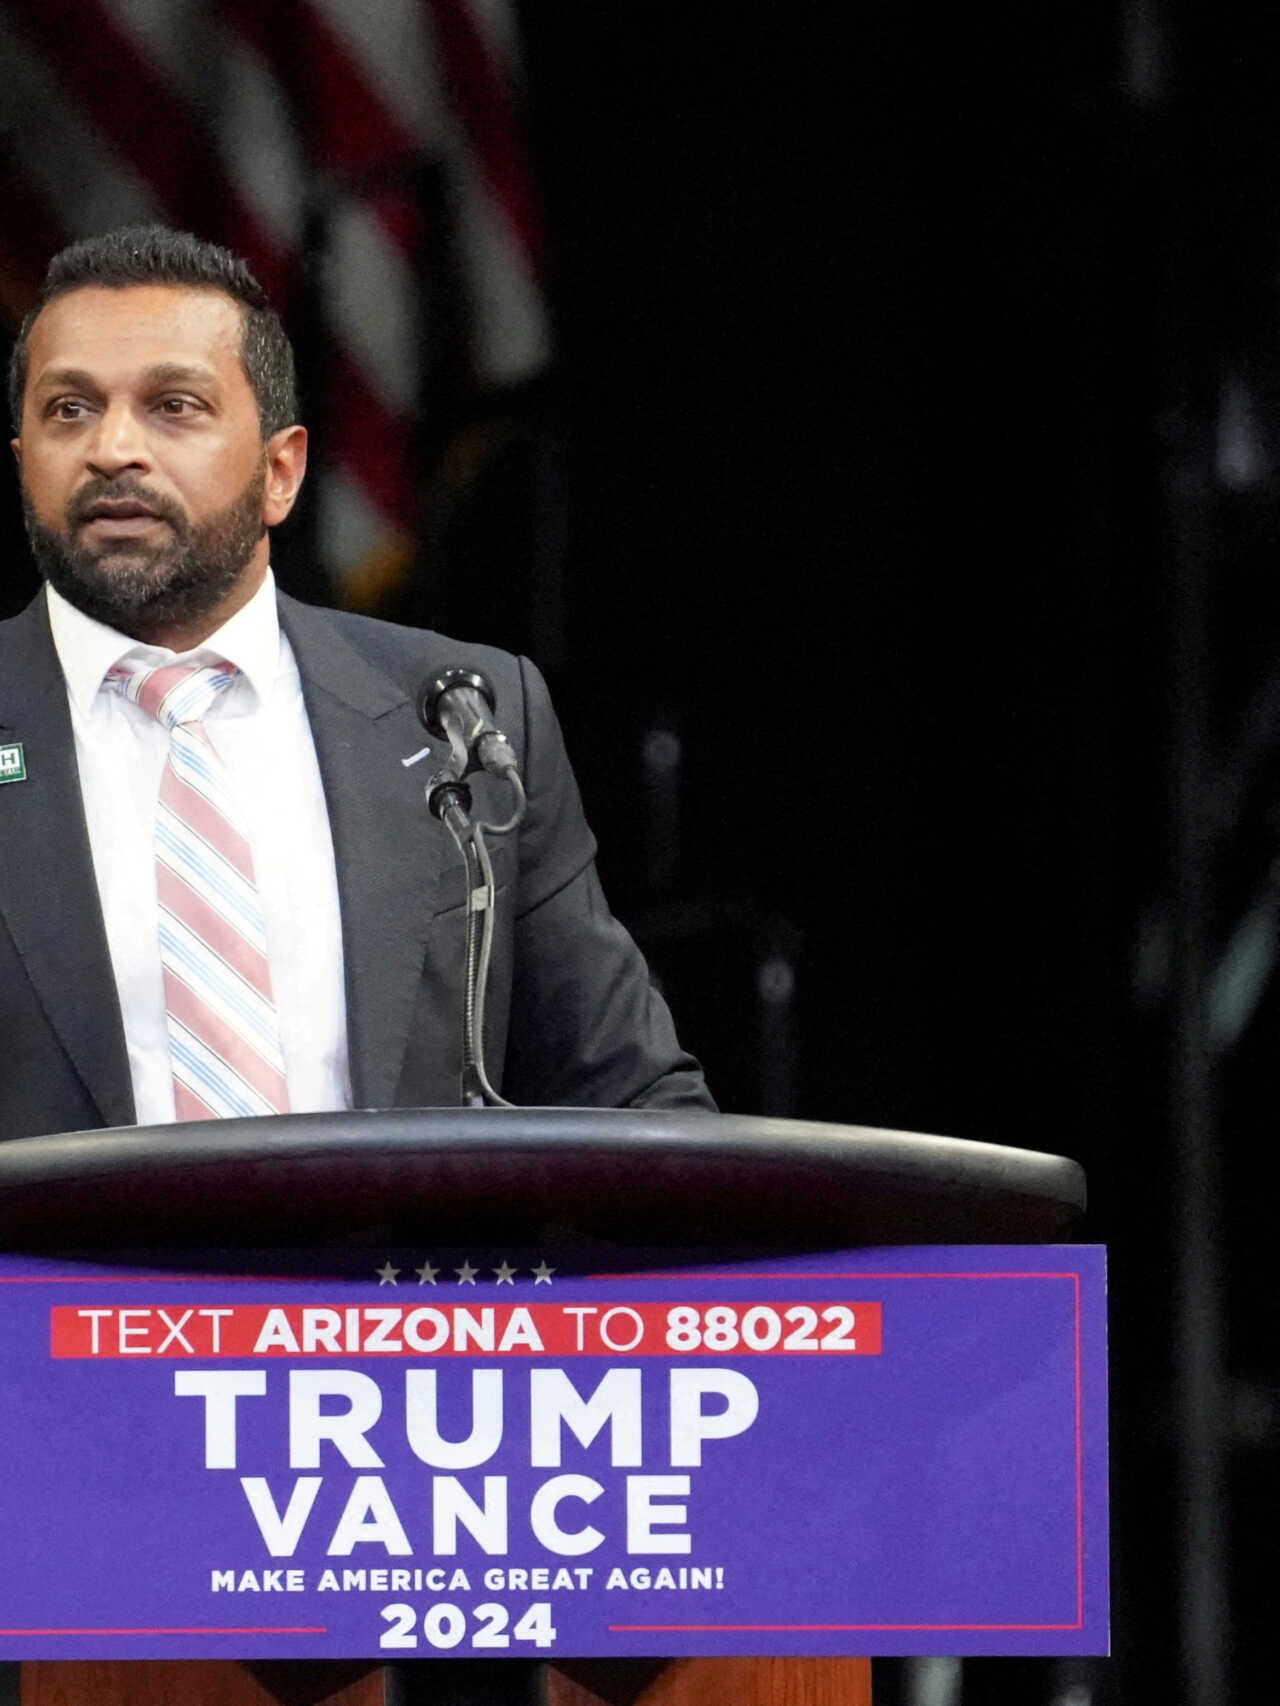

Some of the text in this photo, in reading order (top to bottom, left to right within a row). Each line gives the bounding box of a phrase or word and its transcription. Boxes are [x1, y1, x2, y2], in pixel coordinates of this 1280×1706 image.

[77, 1305, 856, 1355] TEXT ARIZONA TO 88022
[174, 1367, 760, 1470] TRUMP
[239, 1473, 692, 1559] VANCE
[211, 1567, 724, 1593] MAKE AMERICA GREAT AGAIN!
[379, 1602, 558, 1650] 2024
